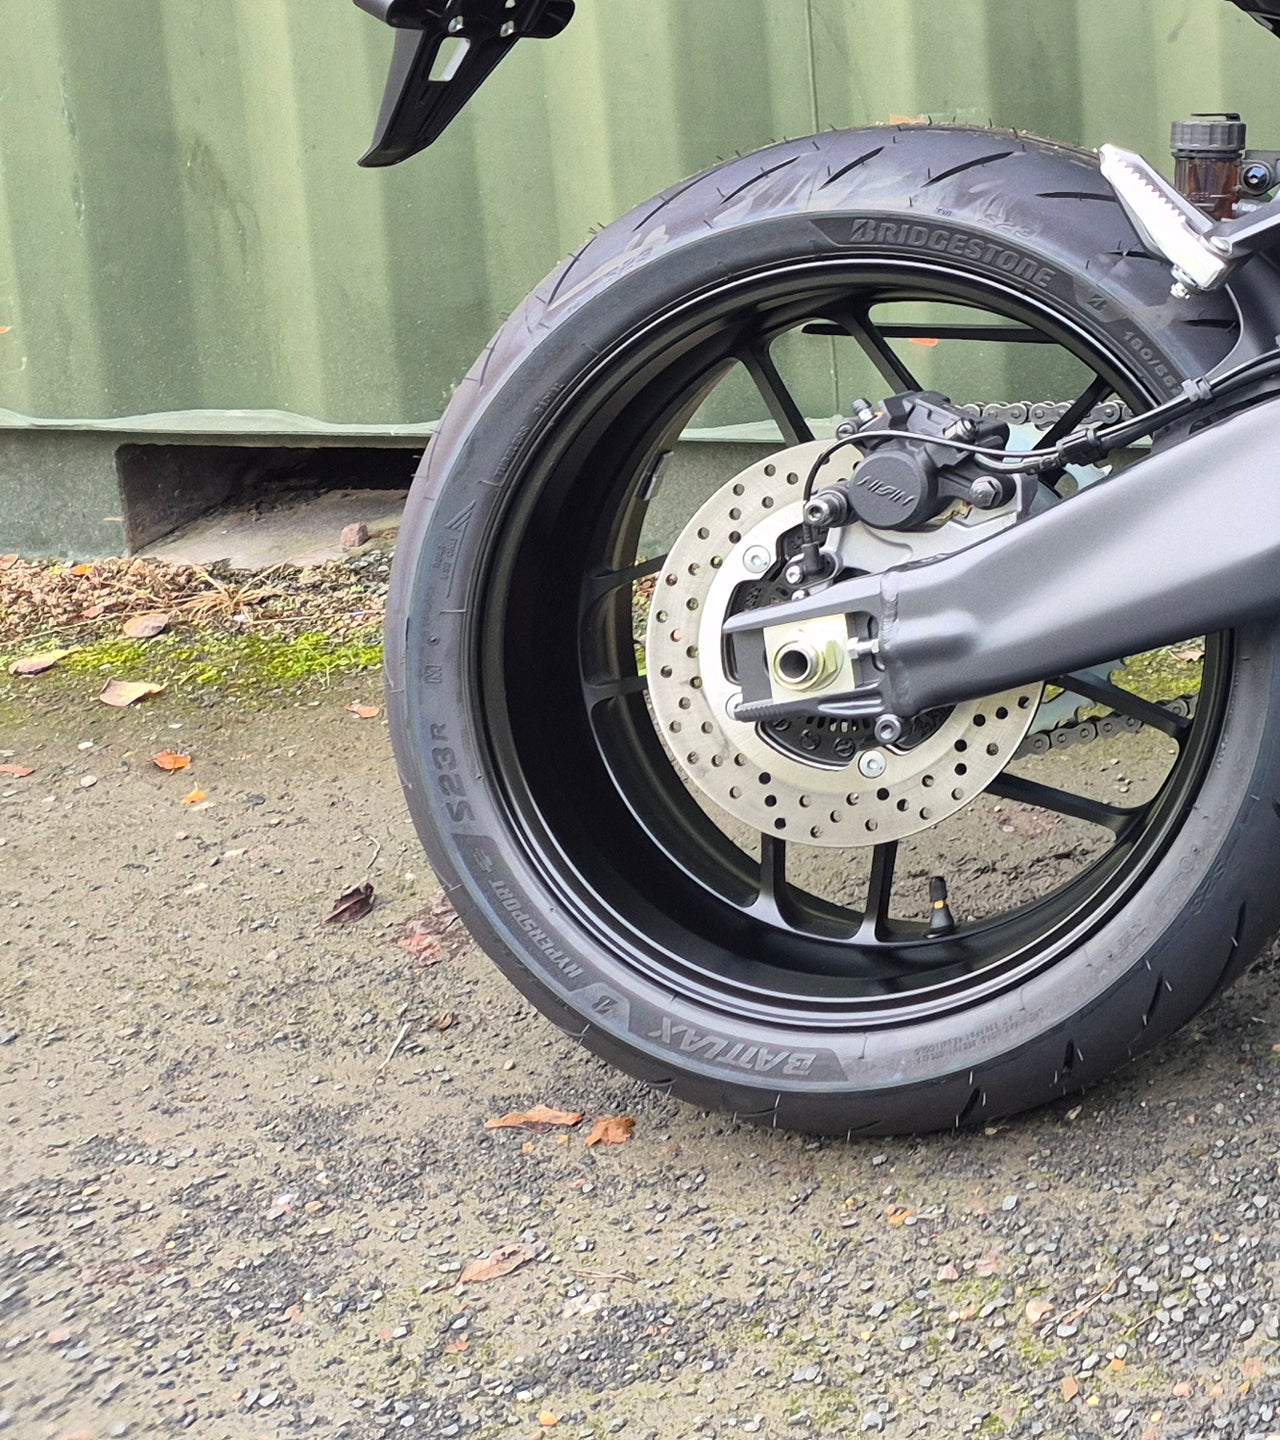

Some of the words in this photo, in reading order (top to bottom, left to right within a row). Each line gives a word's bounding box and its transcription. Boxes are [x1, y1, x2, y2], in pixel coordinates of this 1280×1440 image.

[850, 218, 1056, 288] BRIDGESTONE
[430, 722, 476, 824] S23R
[488, 879, 584, 984] HYPERSPORT
[648, 1016, 818, 1077] BATTLAX
